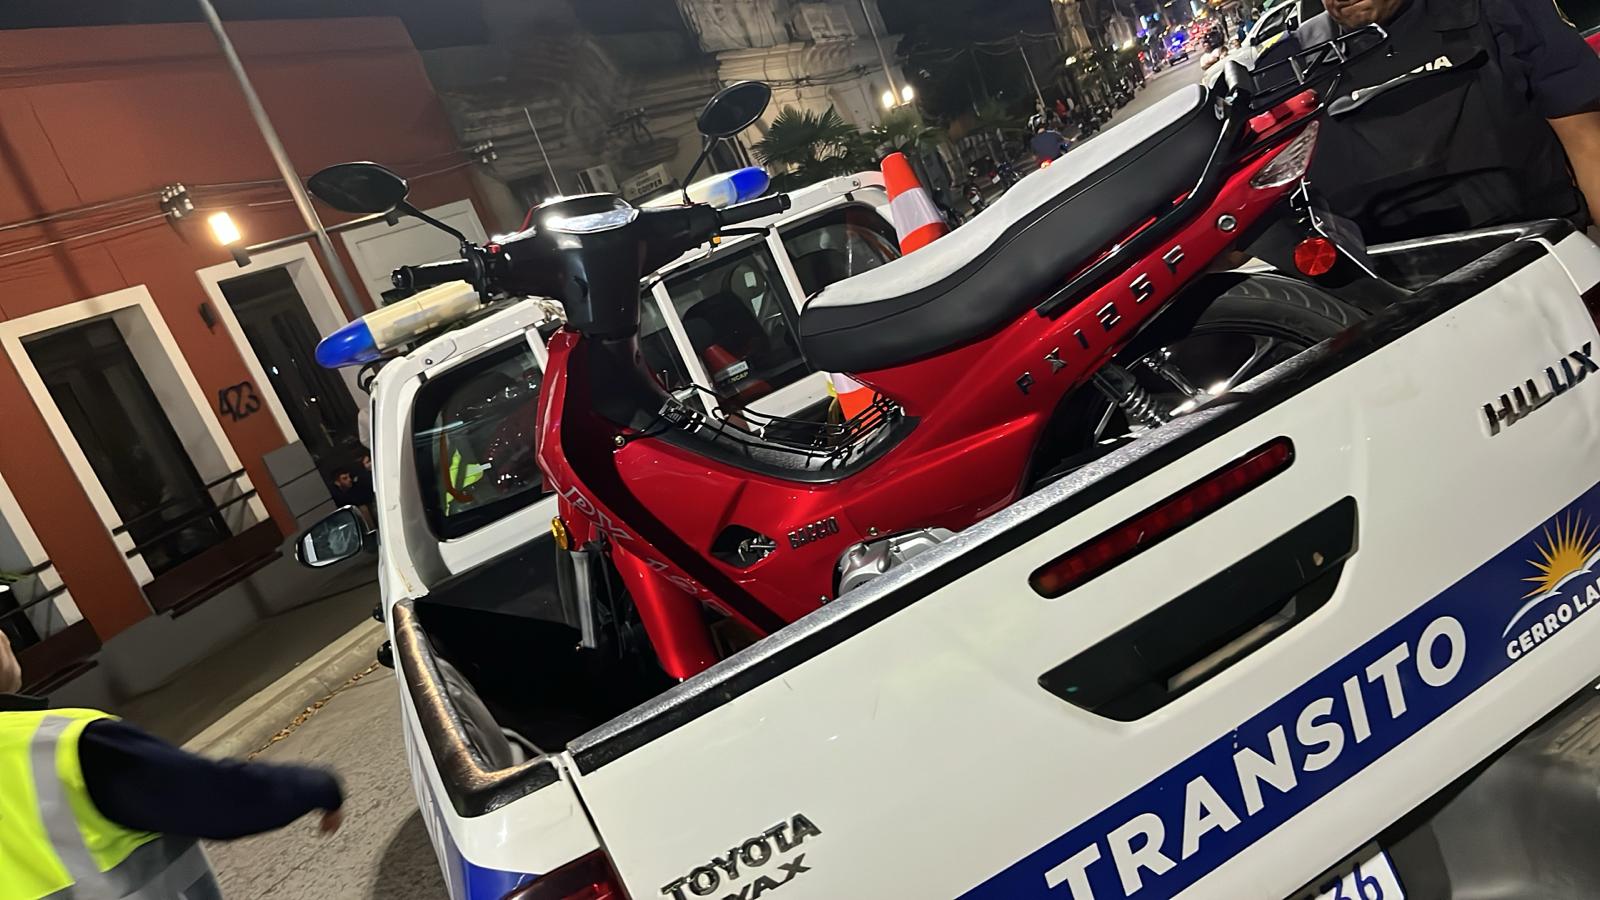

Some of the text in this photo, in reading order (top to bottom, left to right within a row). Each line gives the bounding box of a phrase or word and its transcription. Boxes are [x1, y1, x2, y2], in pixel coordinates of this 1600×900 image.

[218, 381, 261, 423] 423
[1482, 341, 1600, 437] HILUX
[1506, 576, 1600, 660] CERRO LA
[1044, 616, 1466, 900] TRANSITO
[661, 813, 822, 900] TOYOTA
